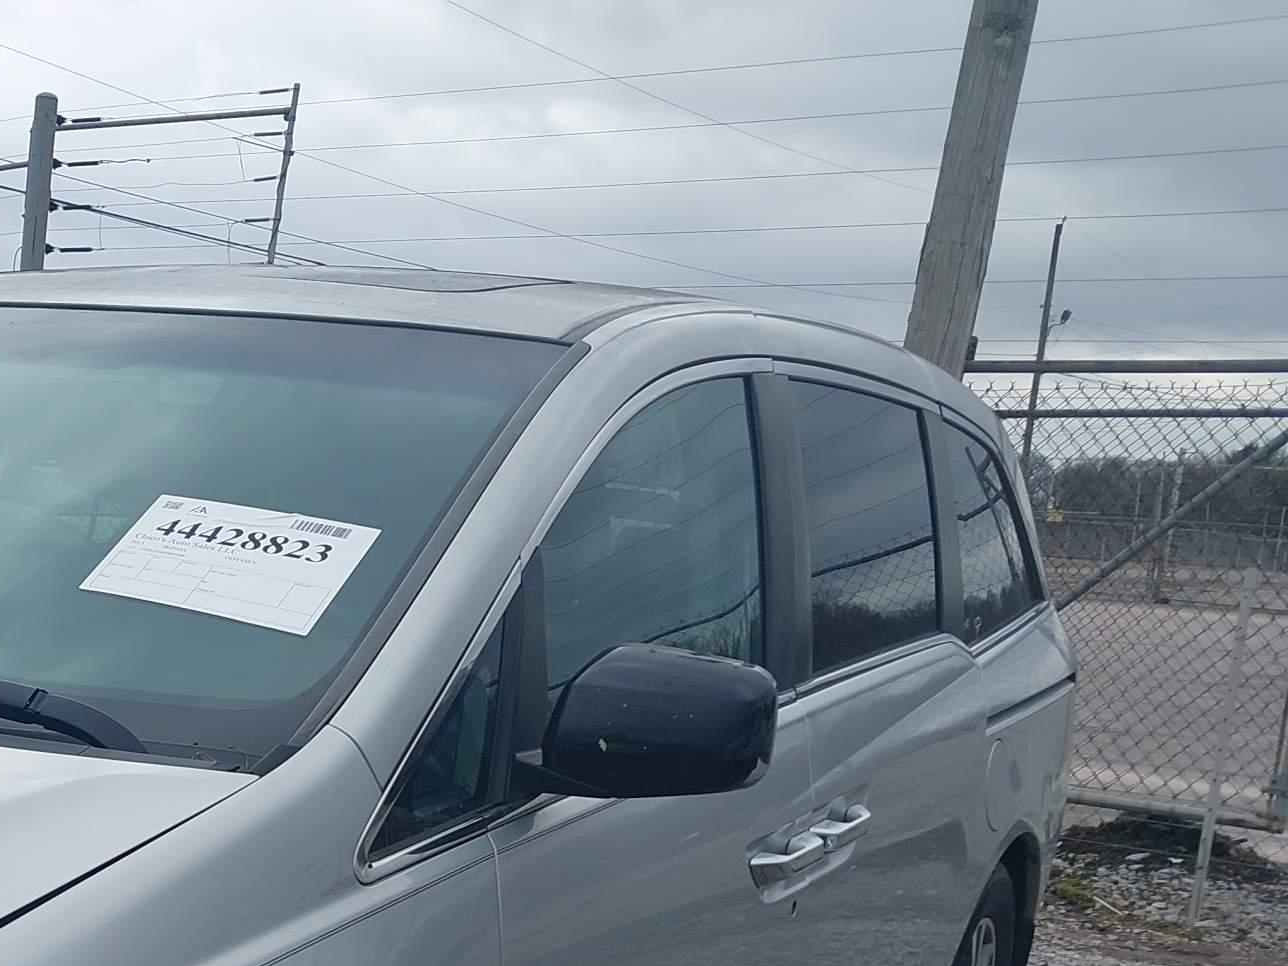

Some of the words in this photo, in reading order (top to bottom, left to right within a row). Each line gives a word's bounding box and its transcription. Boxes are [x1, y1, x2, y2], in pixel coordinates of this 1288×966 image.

[156, 519, 333, 563] 44428823
[168, 538, 191, 547] Auto
[190, 542, 216, 552] Sales
